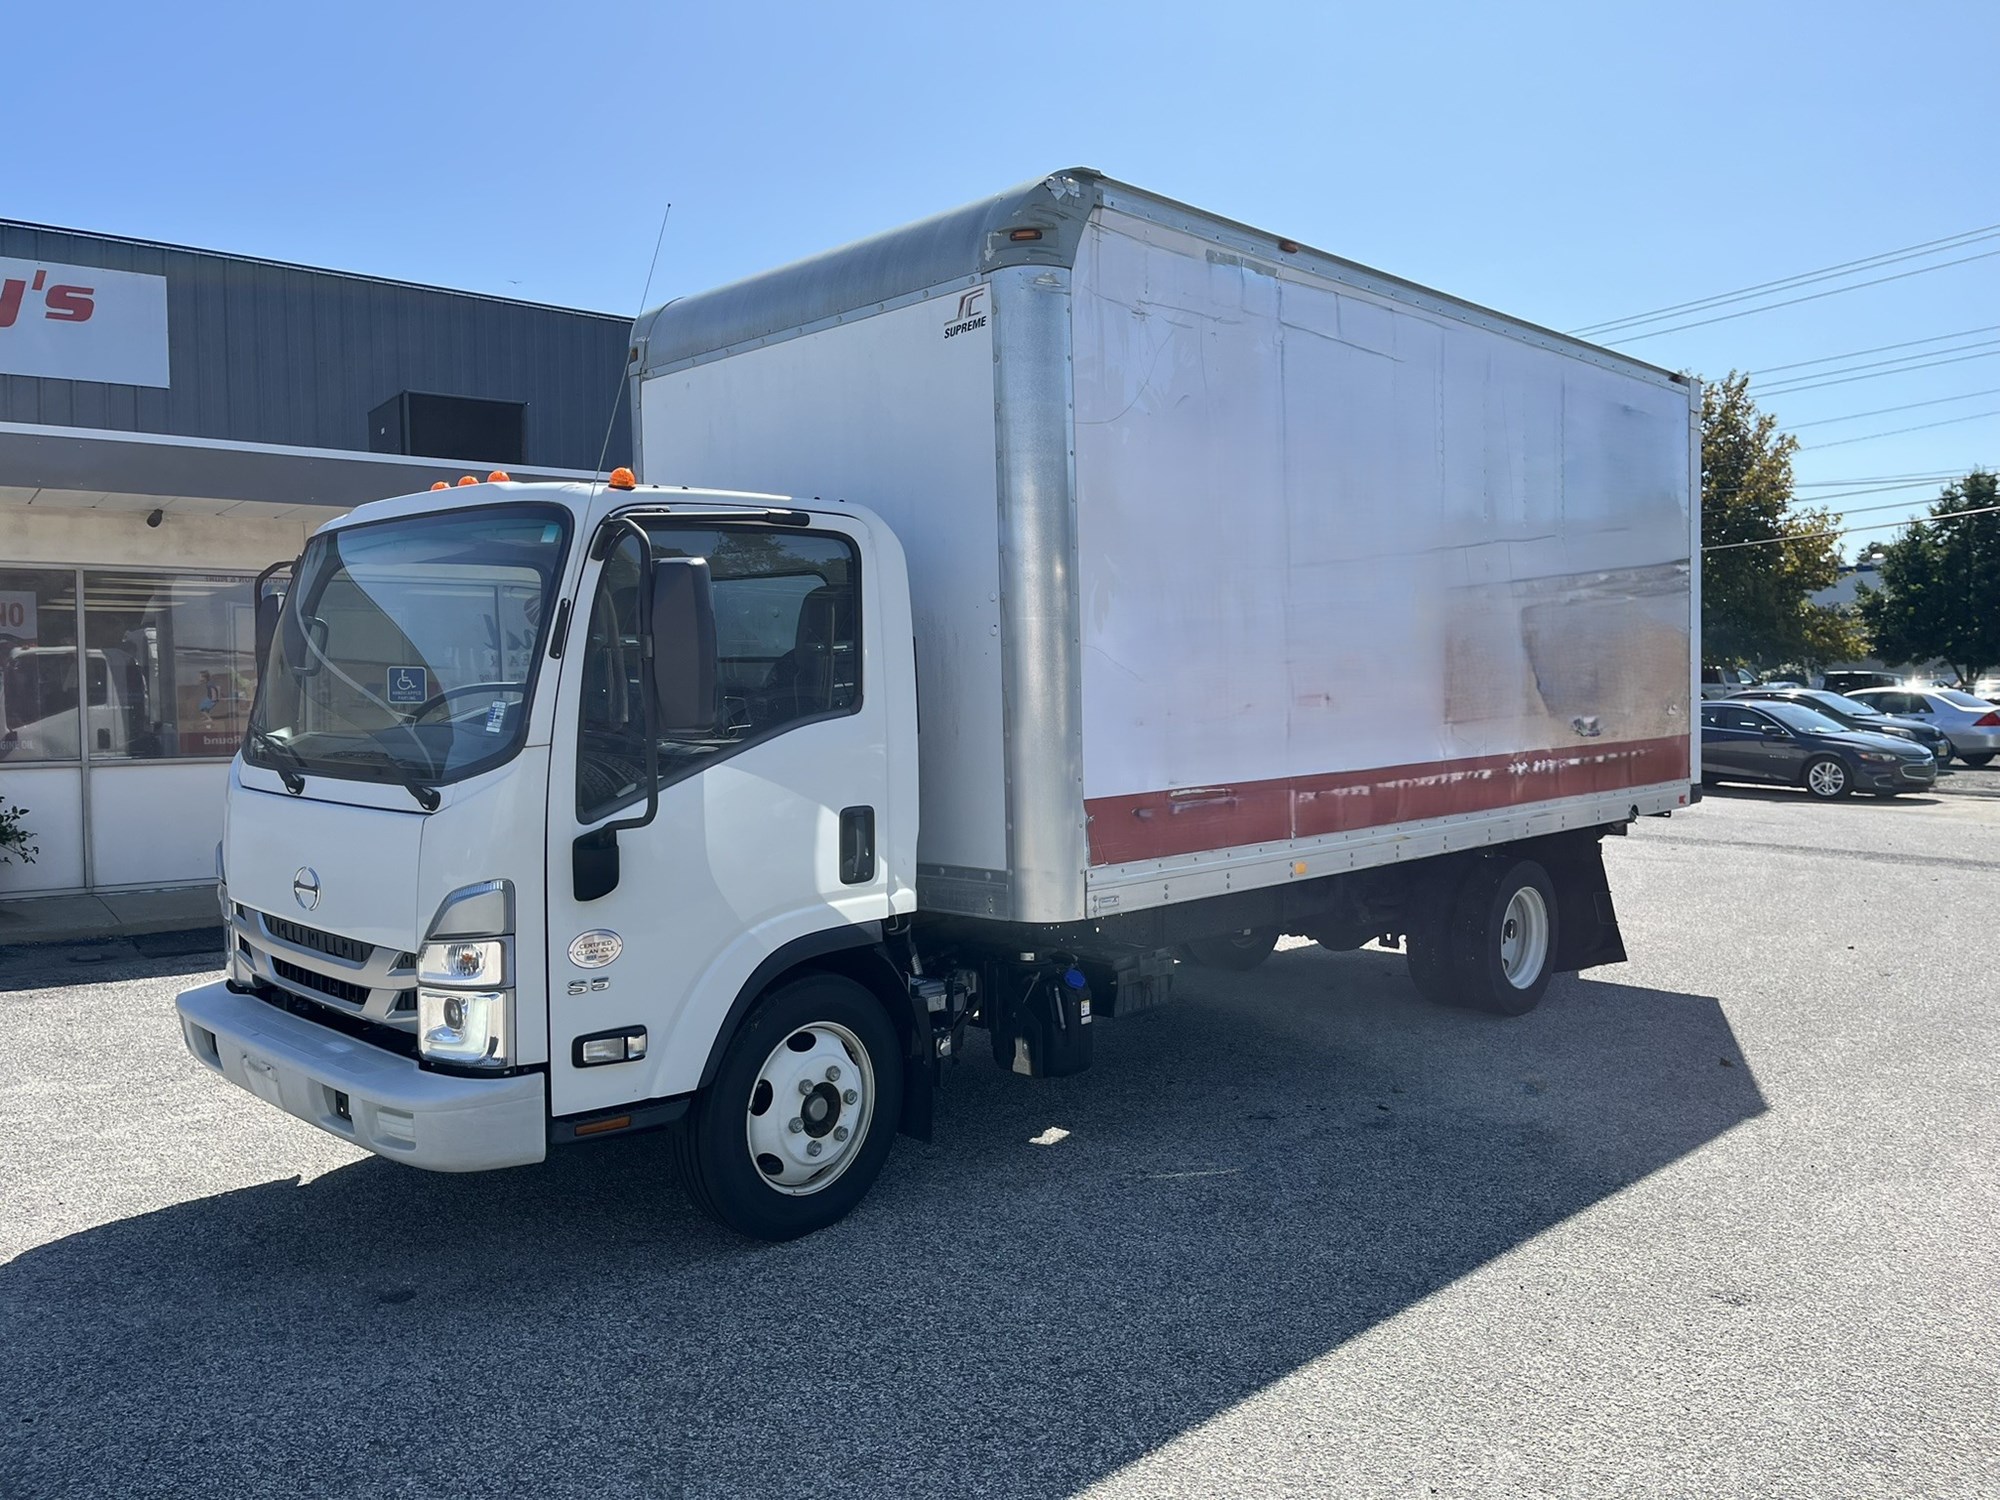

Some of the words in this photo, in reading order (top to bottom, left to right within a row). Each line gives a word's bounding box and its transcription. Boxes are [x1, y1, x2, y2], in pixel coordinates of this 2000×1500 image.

[944, 316, 986, 339] SUPREME
[576, 948, 599, 957] CLEAN
[601, 945, 616, 953] IDLE
[579, 940, 612, 950] CERTIFIED
[567, 977, 610, 995] S5
